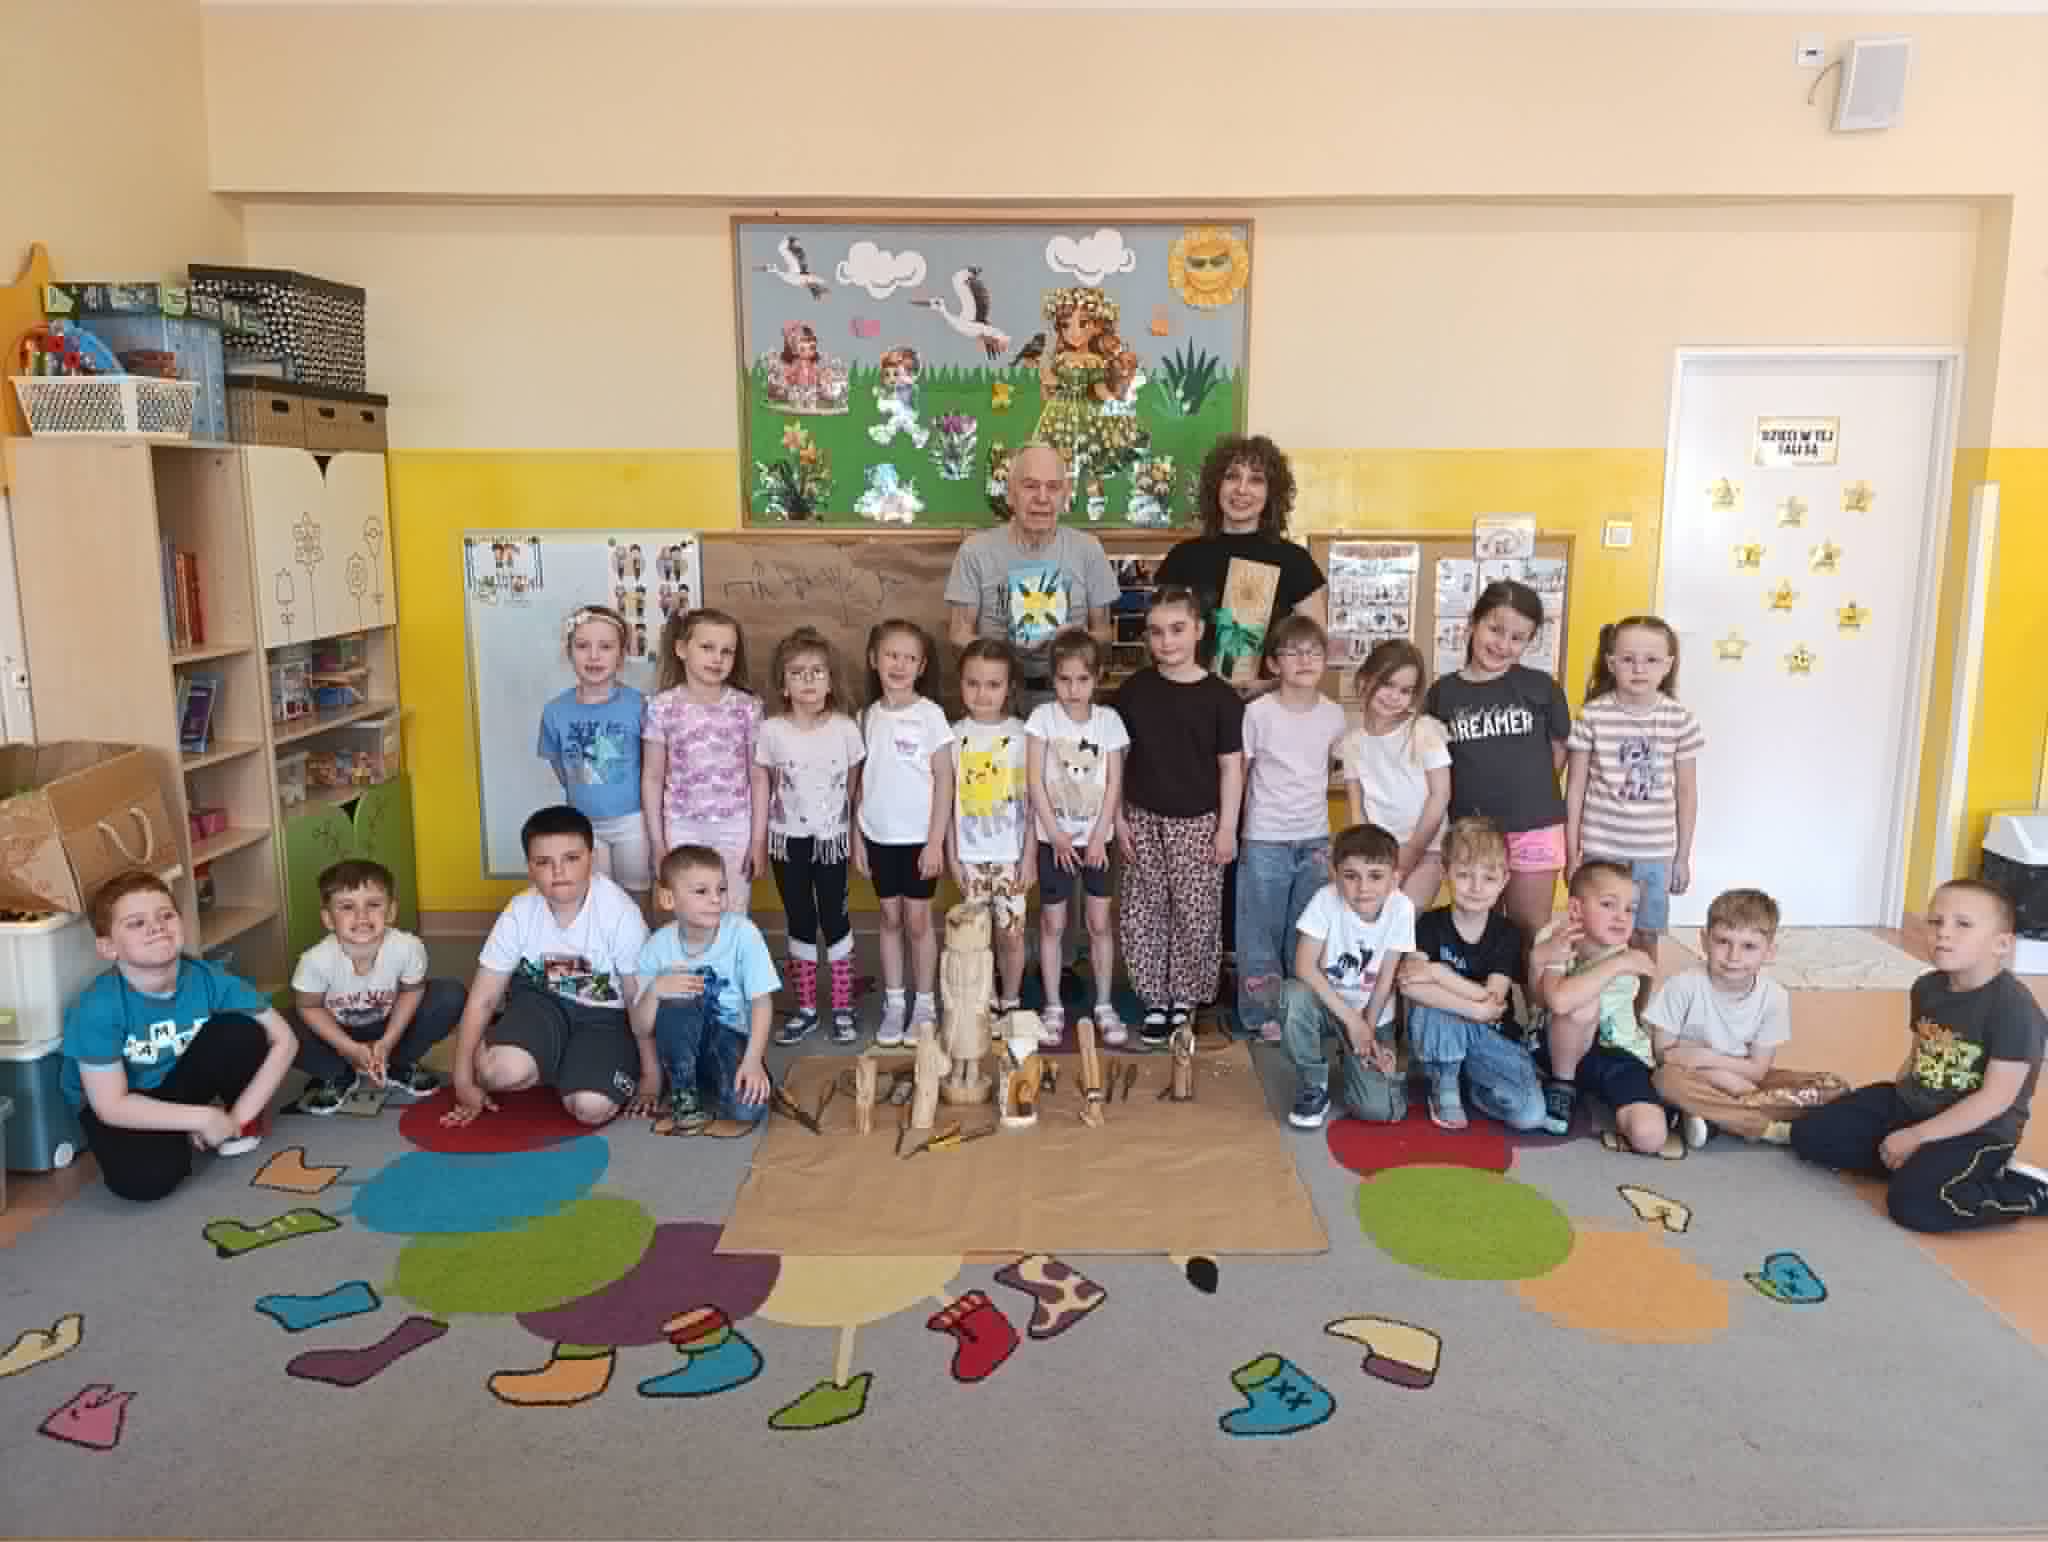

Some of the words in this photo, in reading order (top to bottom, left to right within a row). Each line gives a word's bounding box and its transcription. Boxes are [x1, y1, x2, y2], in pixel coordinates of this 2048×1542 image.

[1761, 429, 1798, 441] DZIECI
[1799, 429, 1811, 441] W
[1815, 429, 1834, 441] TEJ
[1452, 709, 1535, 741] REAMER
